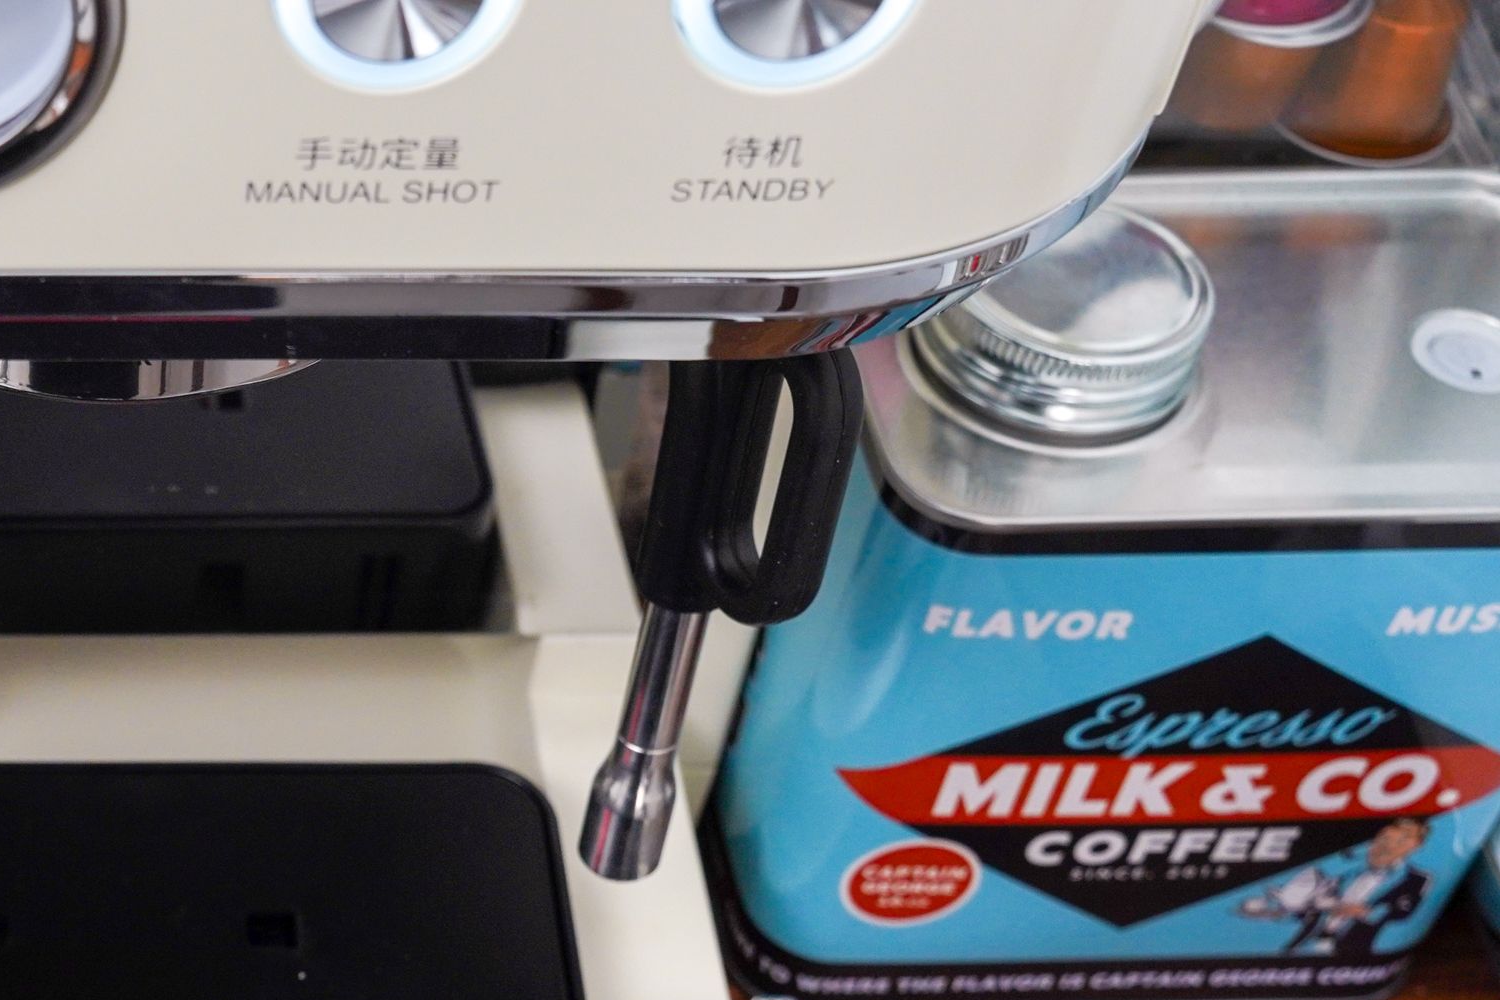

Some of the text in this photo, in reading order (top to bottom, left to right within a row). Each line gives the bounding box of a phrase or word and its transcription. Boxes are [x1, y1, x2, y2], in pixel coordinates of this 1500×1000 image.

[297, 137, 460, 171] 手动定量
[723, 136, 803, 168] 待机
[245, 179, 500, 204] MANUAL SHOT
[671, 178, 835, 202] STANDBY
[923, 604, 1134, 641] FLAVOR
[1063, 693, 1396, 758] Espresso
[931, 754, 1461, 818] MILK & CO.
[1024, 827, 1300, 867] COFFEE
[860, 880, 957, 896] GEORGE
[861, 864, 967, 881] CAPTAIN
[795, 973, 891, 996] WHERE
[897, 974, 949, 995] THE
[951, 972, 1056, 993] FLAVOR
[1088, 969, 1206, 991] CAPTAIN
[1207, 967, 1313, 988] GEORGE
